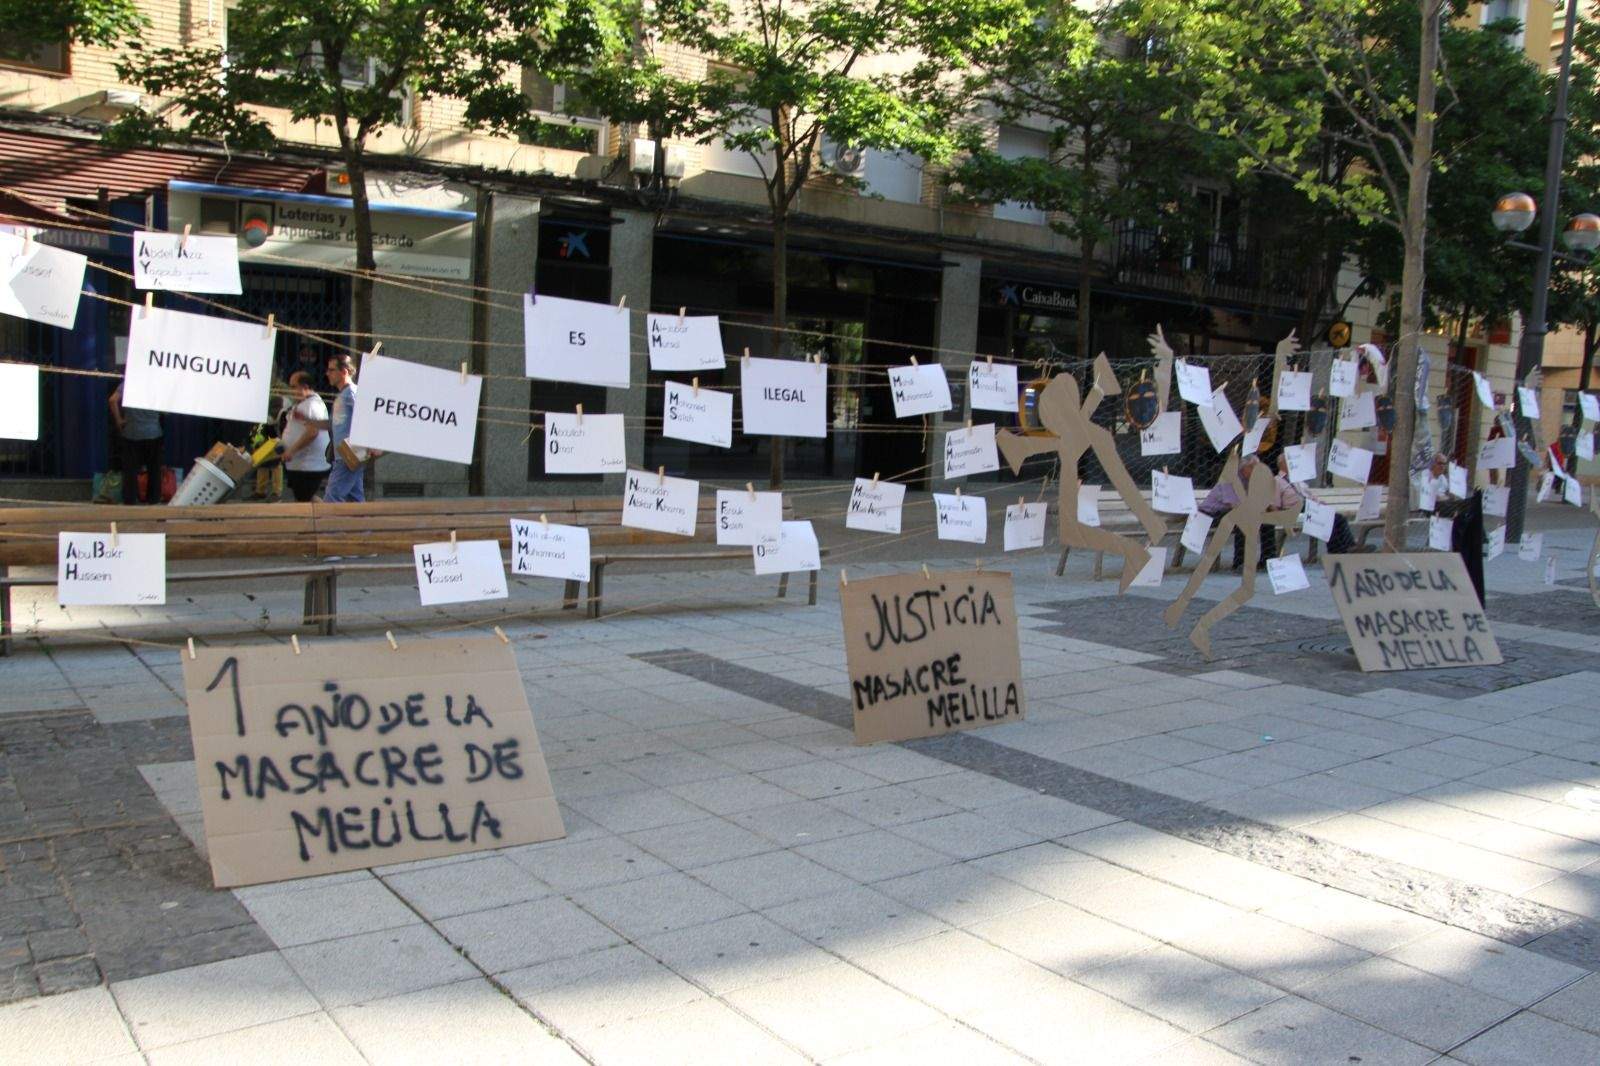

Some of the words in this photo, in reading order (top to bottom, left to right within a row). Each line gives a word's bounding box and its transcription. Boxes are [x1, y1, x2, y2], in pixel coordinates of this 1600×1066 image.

[279, 206, 334, 224] Loterías
[338, 212, 347, 228] y
[279, 224, 341, 242] Apuestas
[1022, 287, 1078, 308] CaixaBank
[568, 330, 586, 346] ES
[148, 349, 251, 380] NINGUNA
[764, 387, 806, 403] ILEGAL
[373, 396, 459, 428] PERSONA
[66, 541, 92, 560] Abu
[93, 541, 125, 560] Bakr
[1331, 562, 1352, 604] 1
[1355, 568, 1394, 598] AÑO
[1396, 569, 1428, 591] DE
[1429, 569, 1458, 591] LA
[865, 584, 1001, 651] JUSTICIA
[1355, 609, 1455, 638] MASACRE
[1462, 612, 1488, 633] DE
[1378, 634, 1484, 669] MELILLA
[853, 653, 967, 710] MASACRE
[206, 656, 246, 737] 1
[275, 681, 371, 746] AÑO
[378, 693, 429, 734] DE
[446, 695, 494, 728] LA
[927, 682, 1020, 728] MELILLA
[215, 743, 445, 800] MASACRE
[464, 738, 524, 783] DE
[291, 797, 503, 861] MELILLA
